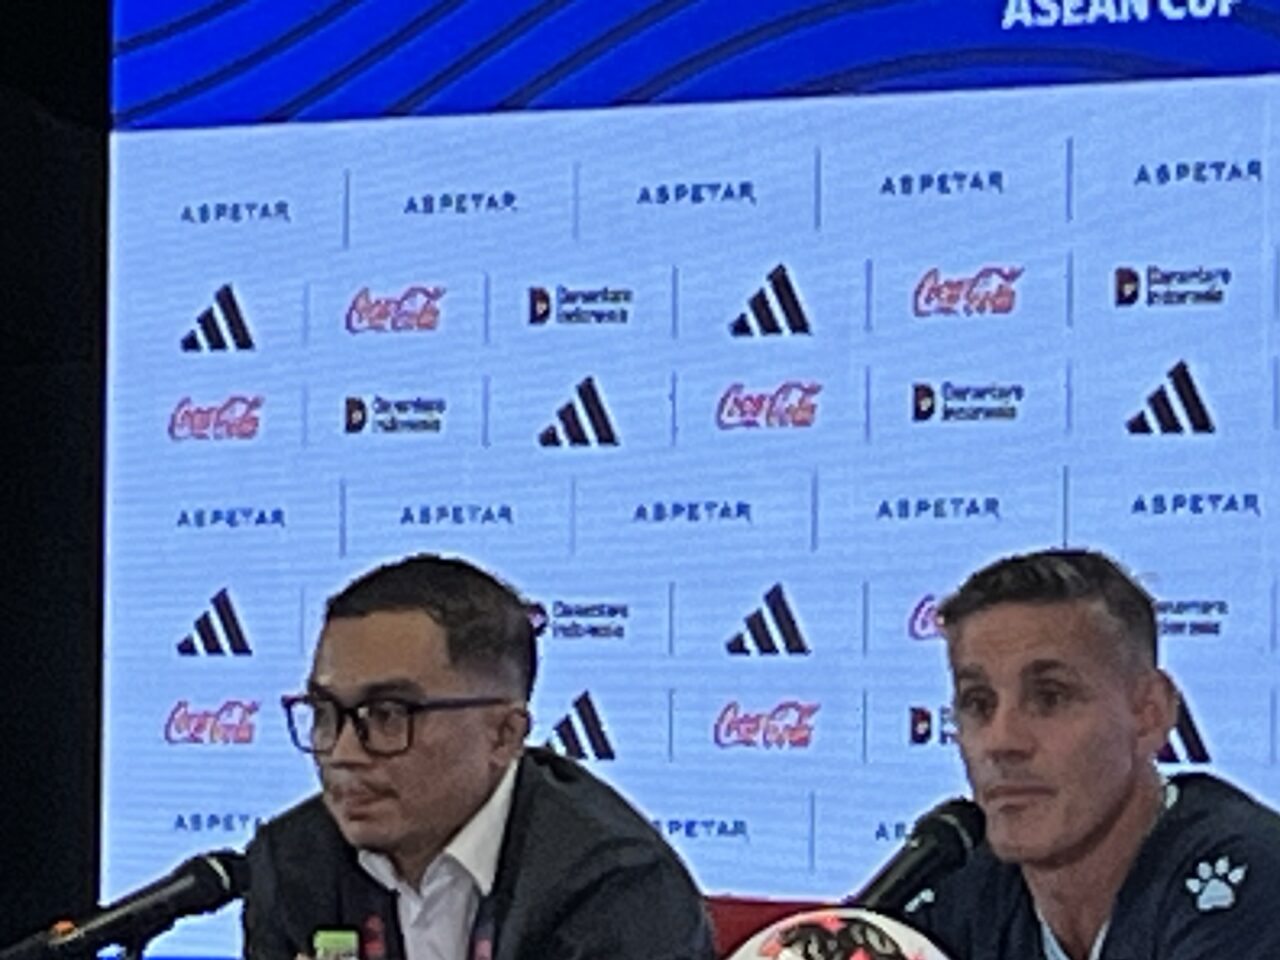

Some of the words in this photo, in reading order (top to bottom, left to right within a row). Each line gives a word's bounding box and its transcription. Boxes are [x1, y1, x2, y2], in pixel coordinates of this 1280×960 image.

[1001, 0, 1149, 29] ASEAN
[880, 171, 1003, 195] ASPETAR
[1134, 159, 1262, 185] ASPETAR
[404, 191, 517, 214] ASPETAR
[637, 181, 756, 204] ASPETAR
[181, 201, 290, 223] ASPETAR
[400, 505, 513, 524] ASPETAR
[634, 501, 750, 522] ASPETAR
[876, 498, 1000, 519] ASPETAR
[1132, 494, 1260, 517] ASPETAR
[177, 508, 285, 528] ASPETAR
[174, 814, 263, 832] ASPET
[653, 819, 750, 842] PETAR
